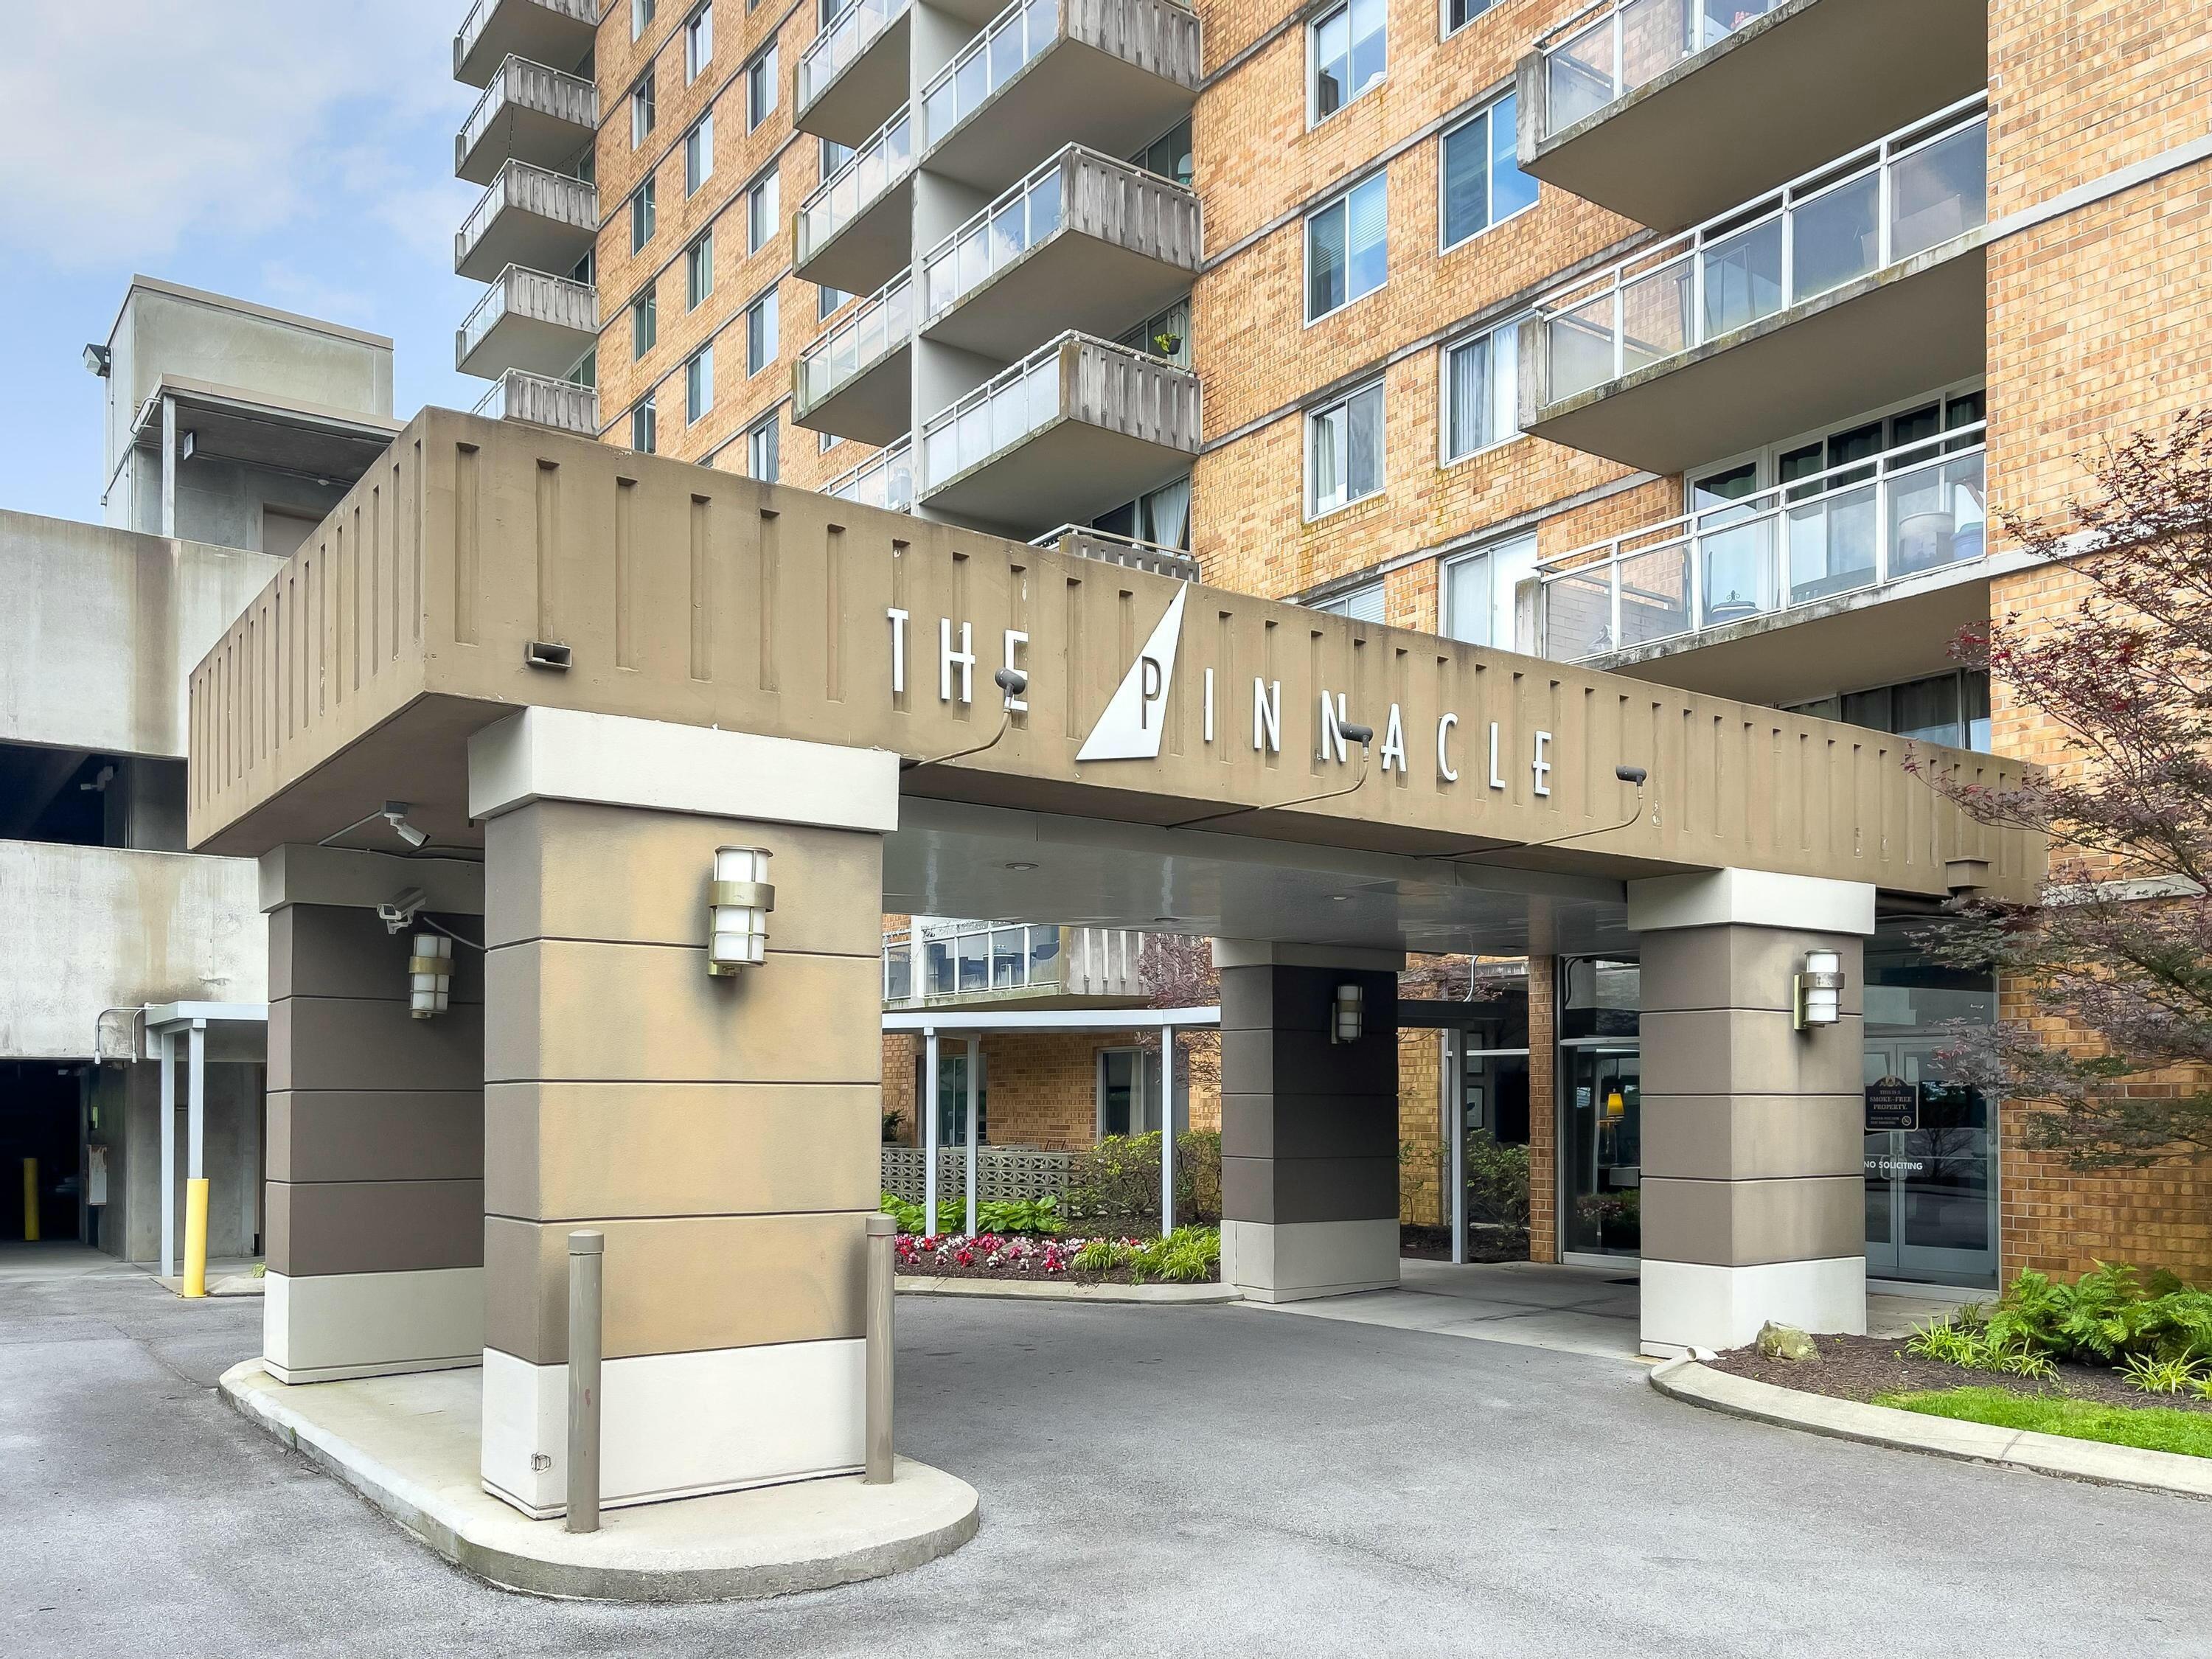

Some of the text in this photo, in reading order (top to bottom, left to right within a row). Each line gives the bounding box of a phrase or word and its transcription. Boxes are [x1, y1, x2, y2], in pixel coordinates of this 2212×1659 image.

[887, 607, 1552, 796] THE PINNACLE
[1863, 1161, 1923, 1170] NO SOLICITING
